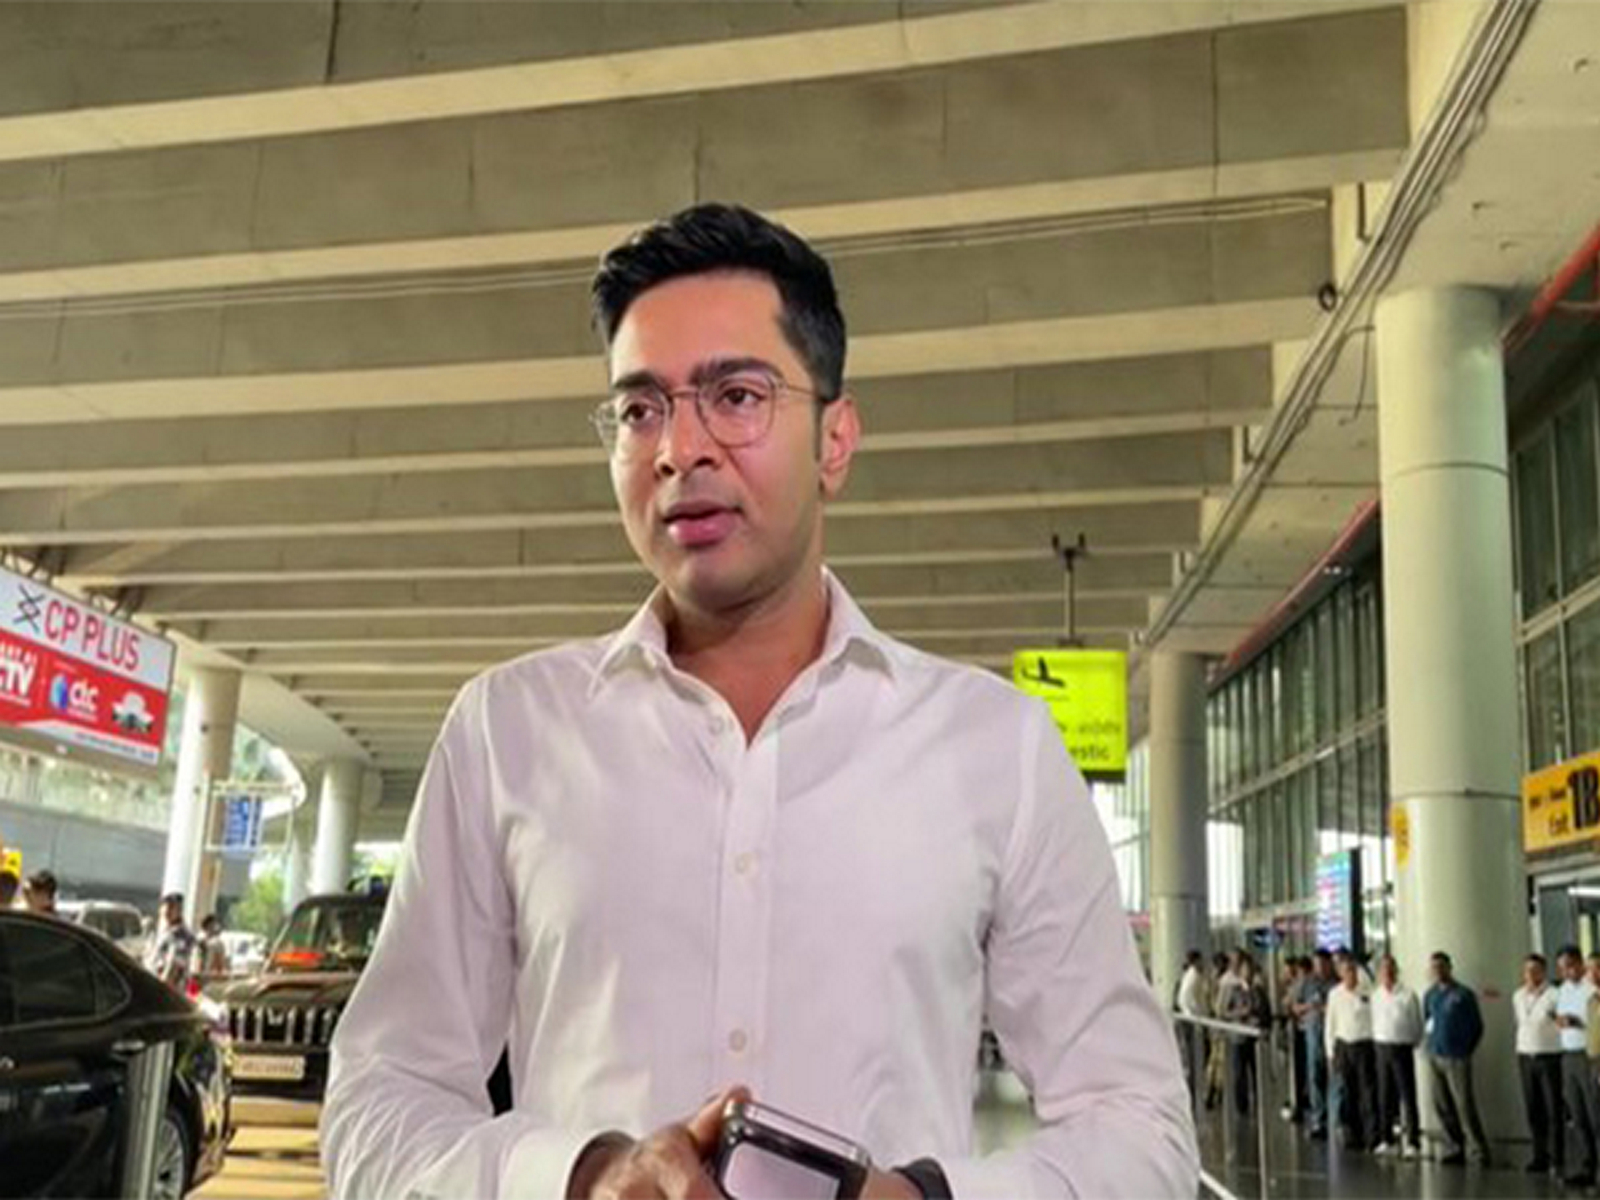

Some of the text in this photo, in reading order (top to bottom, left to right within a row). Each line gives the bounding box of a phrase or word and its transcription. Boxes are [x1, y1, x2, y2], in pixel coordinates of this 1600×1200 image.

[44, 599, 81, 645] CP
[82, 613, 141, 672] PLUS
[1566, 766, 1600, 831] 1B
